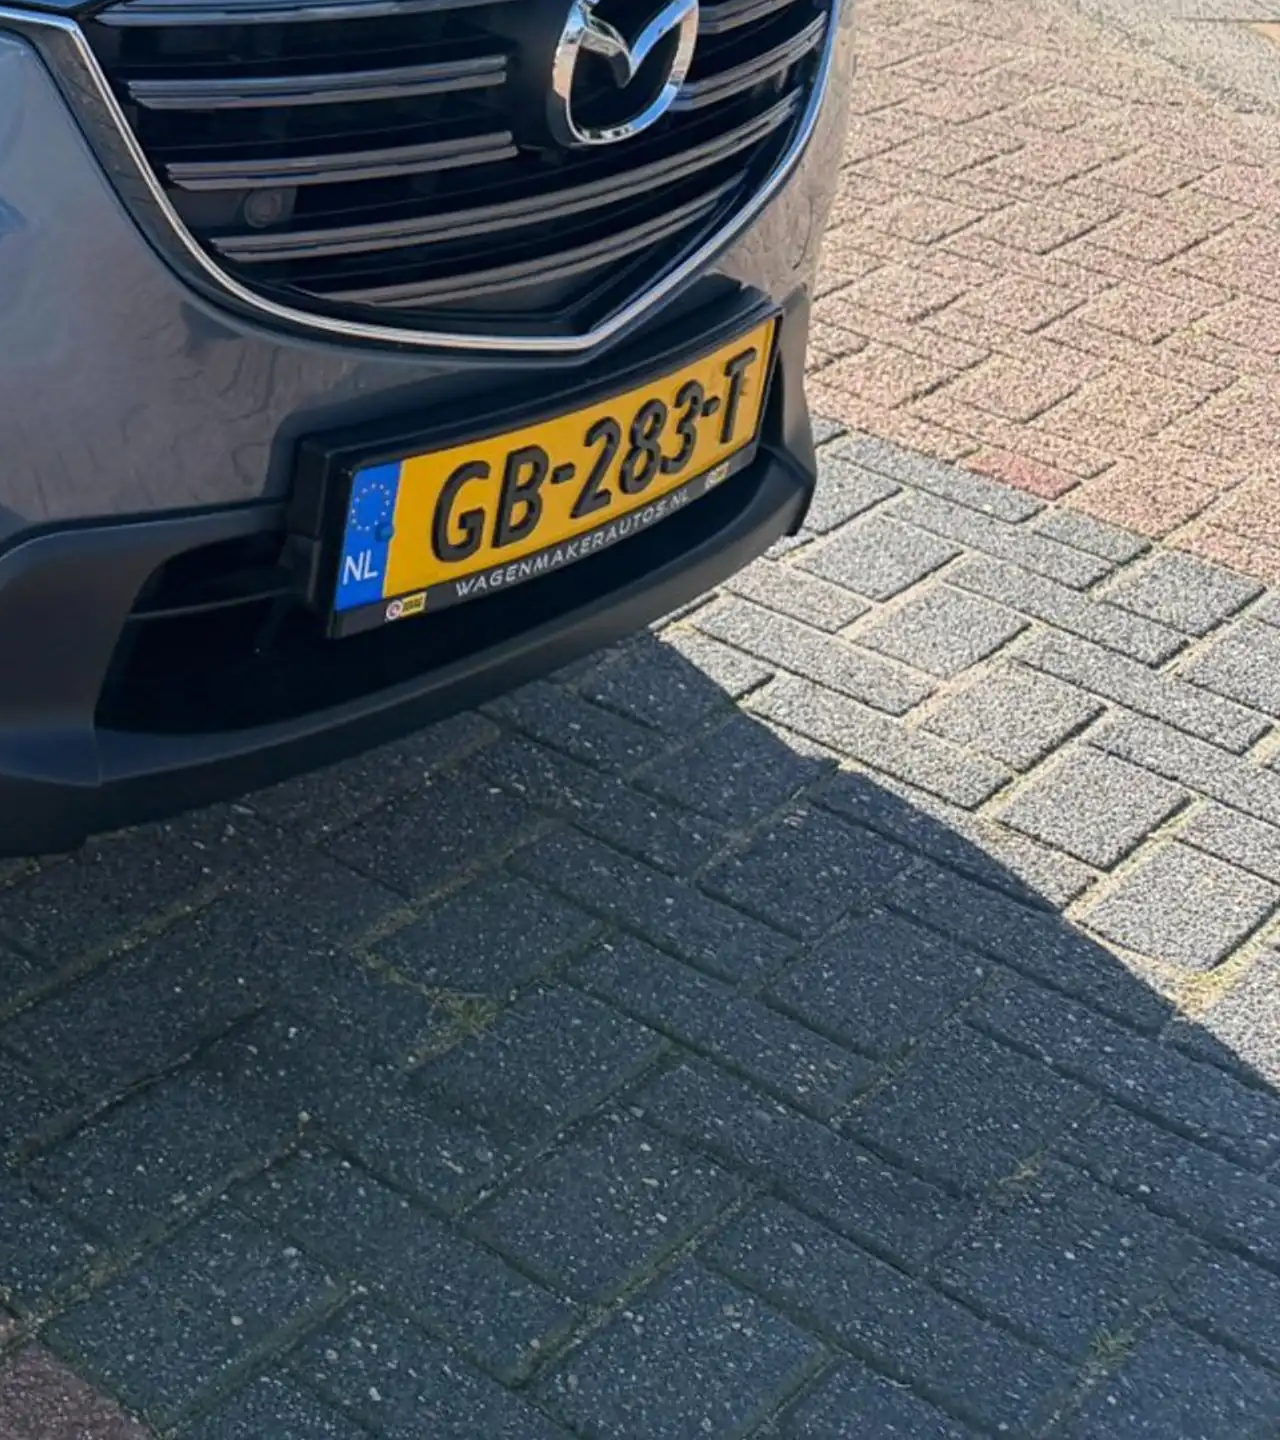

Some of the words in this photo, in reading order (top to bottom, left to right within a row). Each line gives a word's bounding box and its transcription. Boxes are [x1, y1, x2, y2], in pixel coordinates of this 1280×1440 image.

[430, 347, 758, 563] GB-283-T
[342, 549, 378, 586] NL
[455, 487, 690, 597] WAGENMAKERAUTOS.NL
